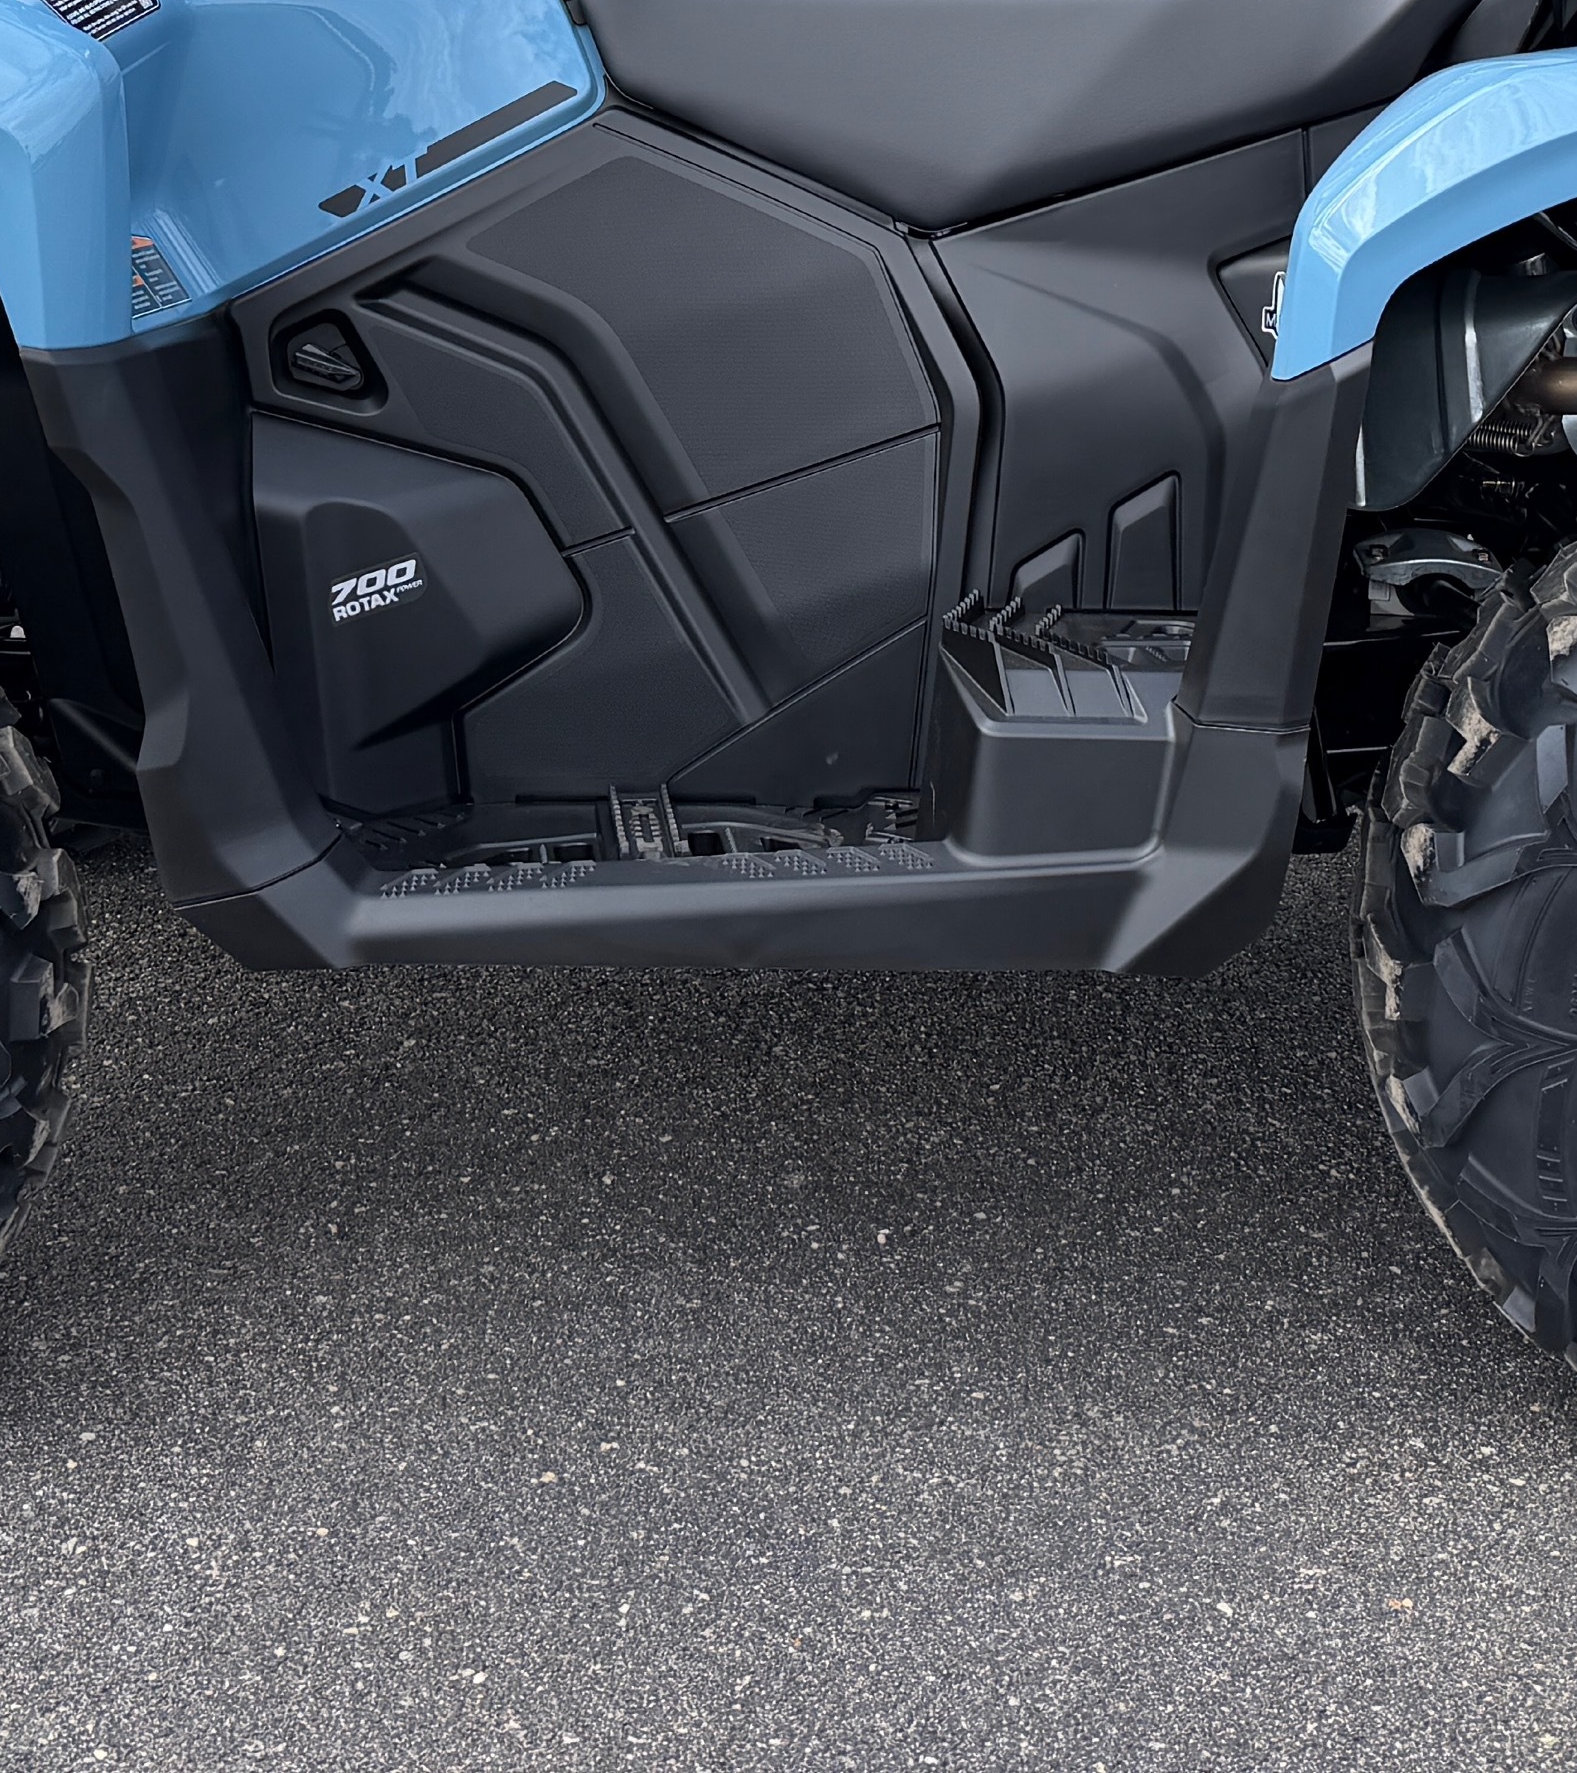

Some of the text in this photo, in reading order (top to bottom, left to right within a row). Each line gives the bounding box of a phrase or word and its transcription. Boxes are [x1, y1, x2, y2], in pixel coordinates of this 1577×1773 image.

[331, 559, 417, 606] 700
[332, 579, 423, 622] ROTAX POWER
